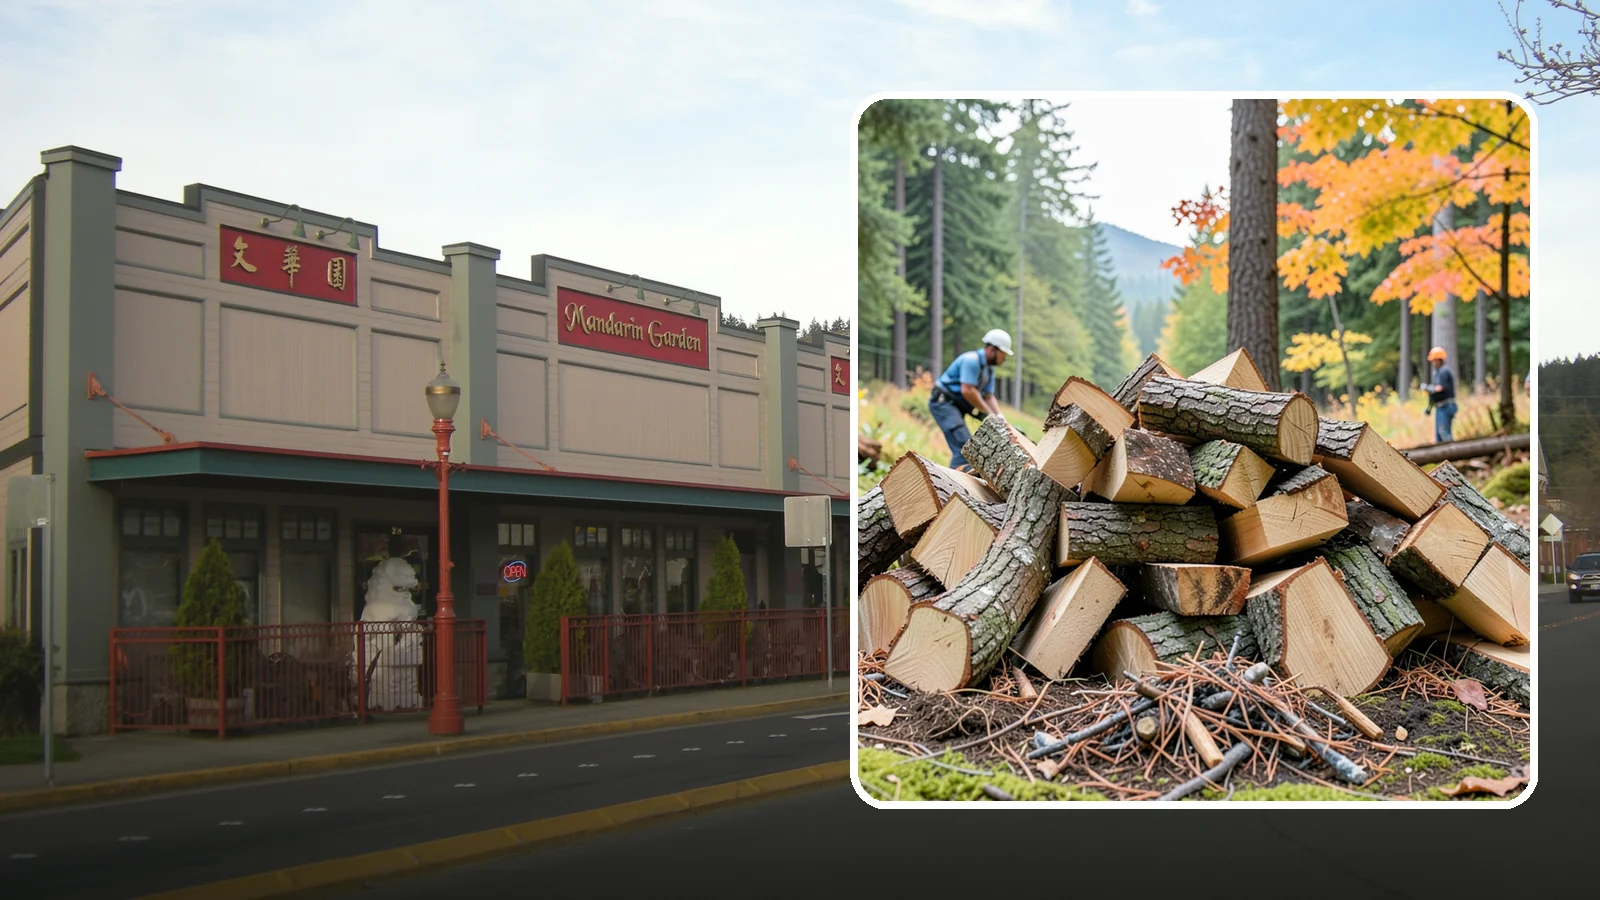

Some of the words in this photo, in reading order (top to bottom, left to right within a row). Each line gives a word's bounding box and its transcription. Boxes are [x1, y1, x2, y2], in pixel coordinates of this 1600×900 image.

[231, 236, 346, 291] 文華園
[564, 302, 644, 341] Mandarin
[648, 320, 701, 352] Garden
[503, 565, 527, 578] OPEN
